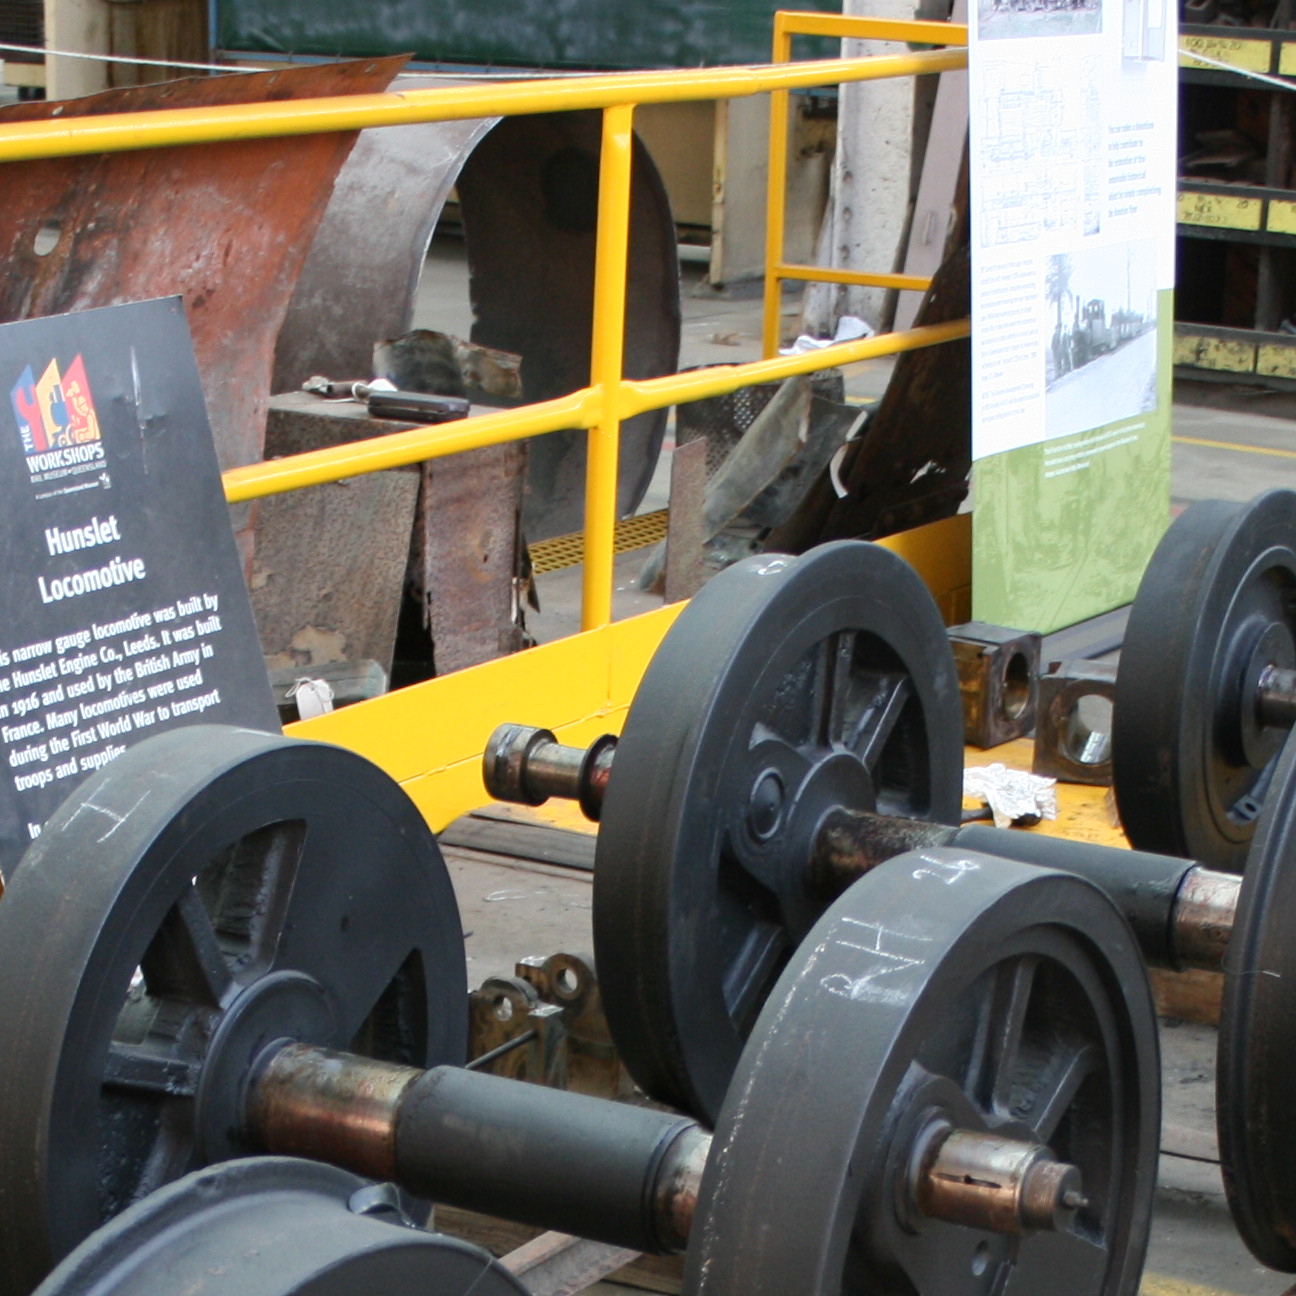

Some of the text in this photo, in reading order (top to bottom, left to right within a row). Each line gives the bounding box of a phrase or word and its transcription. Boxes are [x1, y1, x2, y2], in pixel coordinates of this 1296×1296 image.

[20, 424, 34, 452] THE
[25, 441, 105, 474] WORKSHOPS
[45, 515, 121, 556] Hunslet
[38, 556, 146, 604] Locomotive
[11, 661, 59, 689] Hunslet
[58, 652, 99, 675] Engine
[99, 646, 123, 663] Co.,
[123, 633, 161, 657] Leeds.
[161, 630, 172, 646] It
[172, 625, 195, 642] was
[195, 615, 222, 636] built
[12, 640, 53, 663] narrow
[55, 630, 92, 655] gauge
[92, 612, 152, 641] locomotive
[153, 606, 177, 623] was
[176, 596, 204, 617] built
[203, 593, 218, 612] by
[1, 668, 203, 743] France. Many locomotives were used
[11, 691, 40, 717] 1916
[41, 684, 65, 706] and
[66, 675, 95, 698] used
[96, 672, 112, 692] by
[113, 666, 134, 684] the
[134, 654, 171, 678] British
[172, 648, 200, 665] Army
[200, 642, 214, 659] in
[9, 689, 221, 767] during the First World War to transport
[14, 768, 53, 791] troops
[54, 757, 79, 779] and
